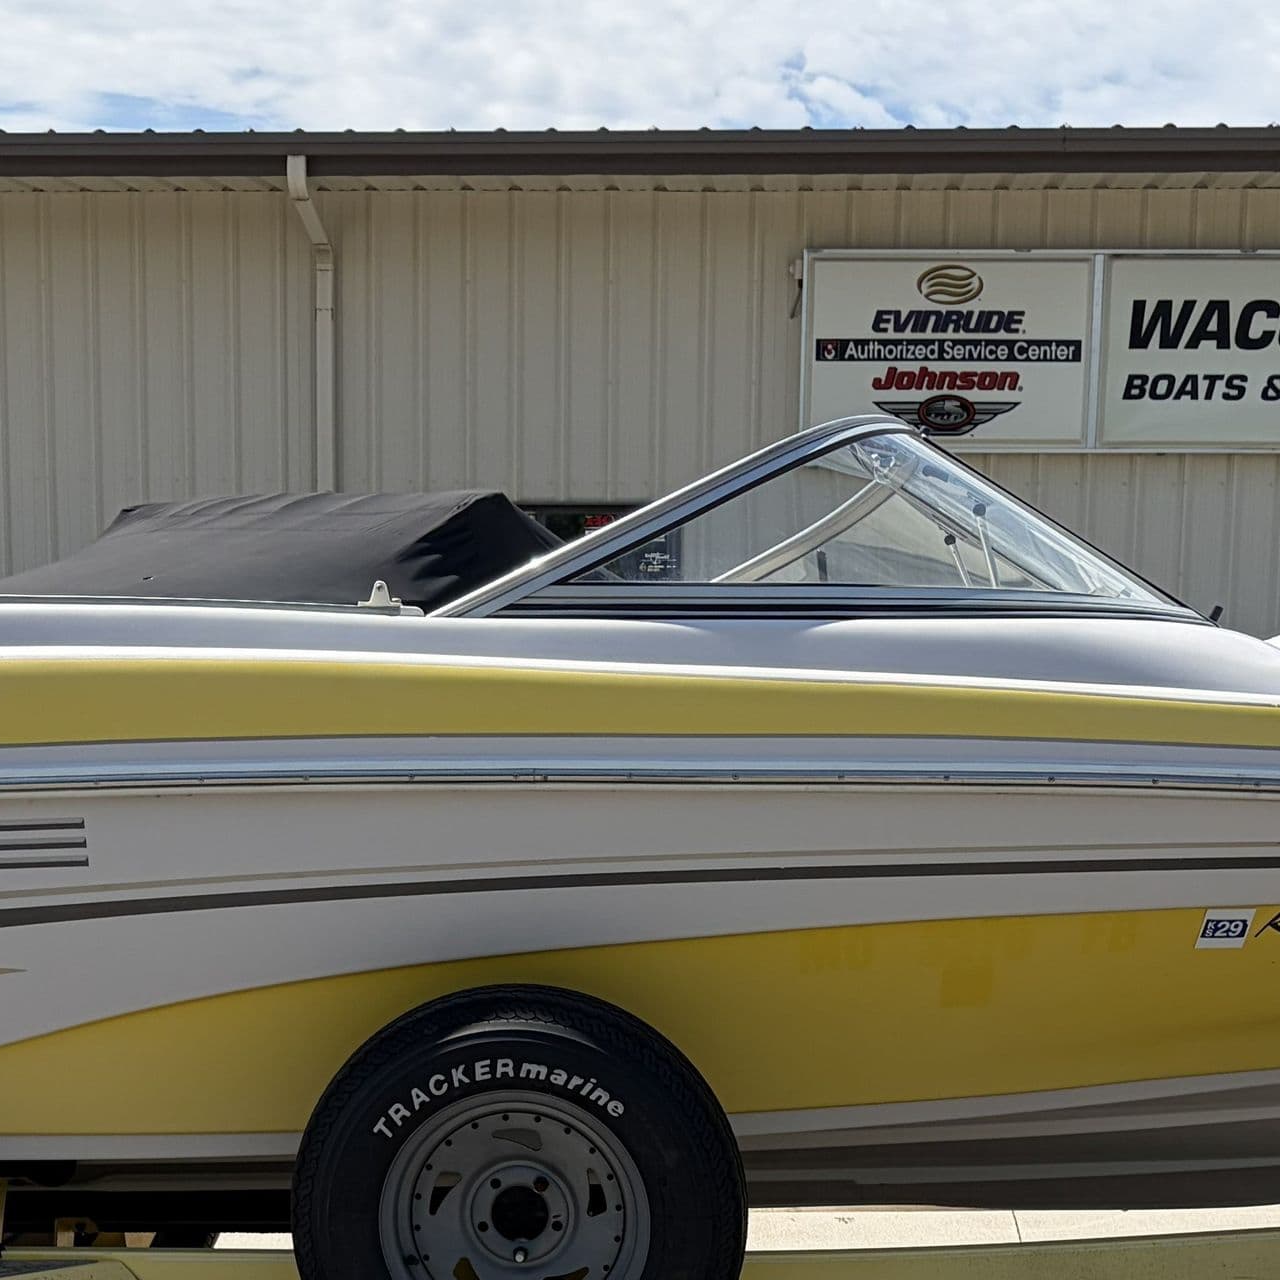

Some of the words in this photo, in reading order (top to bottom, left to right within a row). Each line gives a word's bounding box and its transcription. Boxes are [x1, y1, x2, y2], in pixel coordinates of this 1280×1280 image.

[871, 310, 1025, 334] EVINRUDE
[844, 341, 938, 360] Authorized
[943, 341, 1009, 360] Service
[1013, 341, 1075, 360] Center
[871, 366, 1021, 391] Johnson
[1122, 373, 1248, 401] BOATS
[1214, 920, 1244, 937] 29
